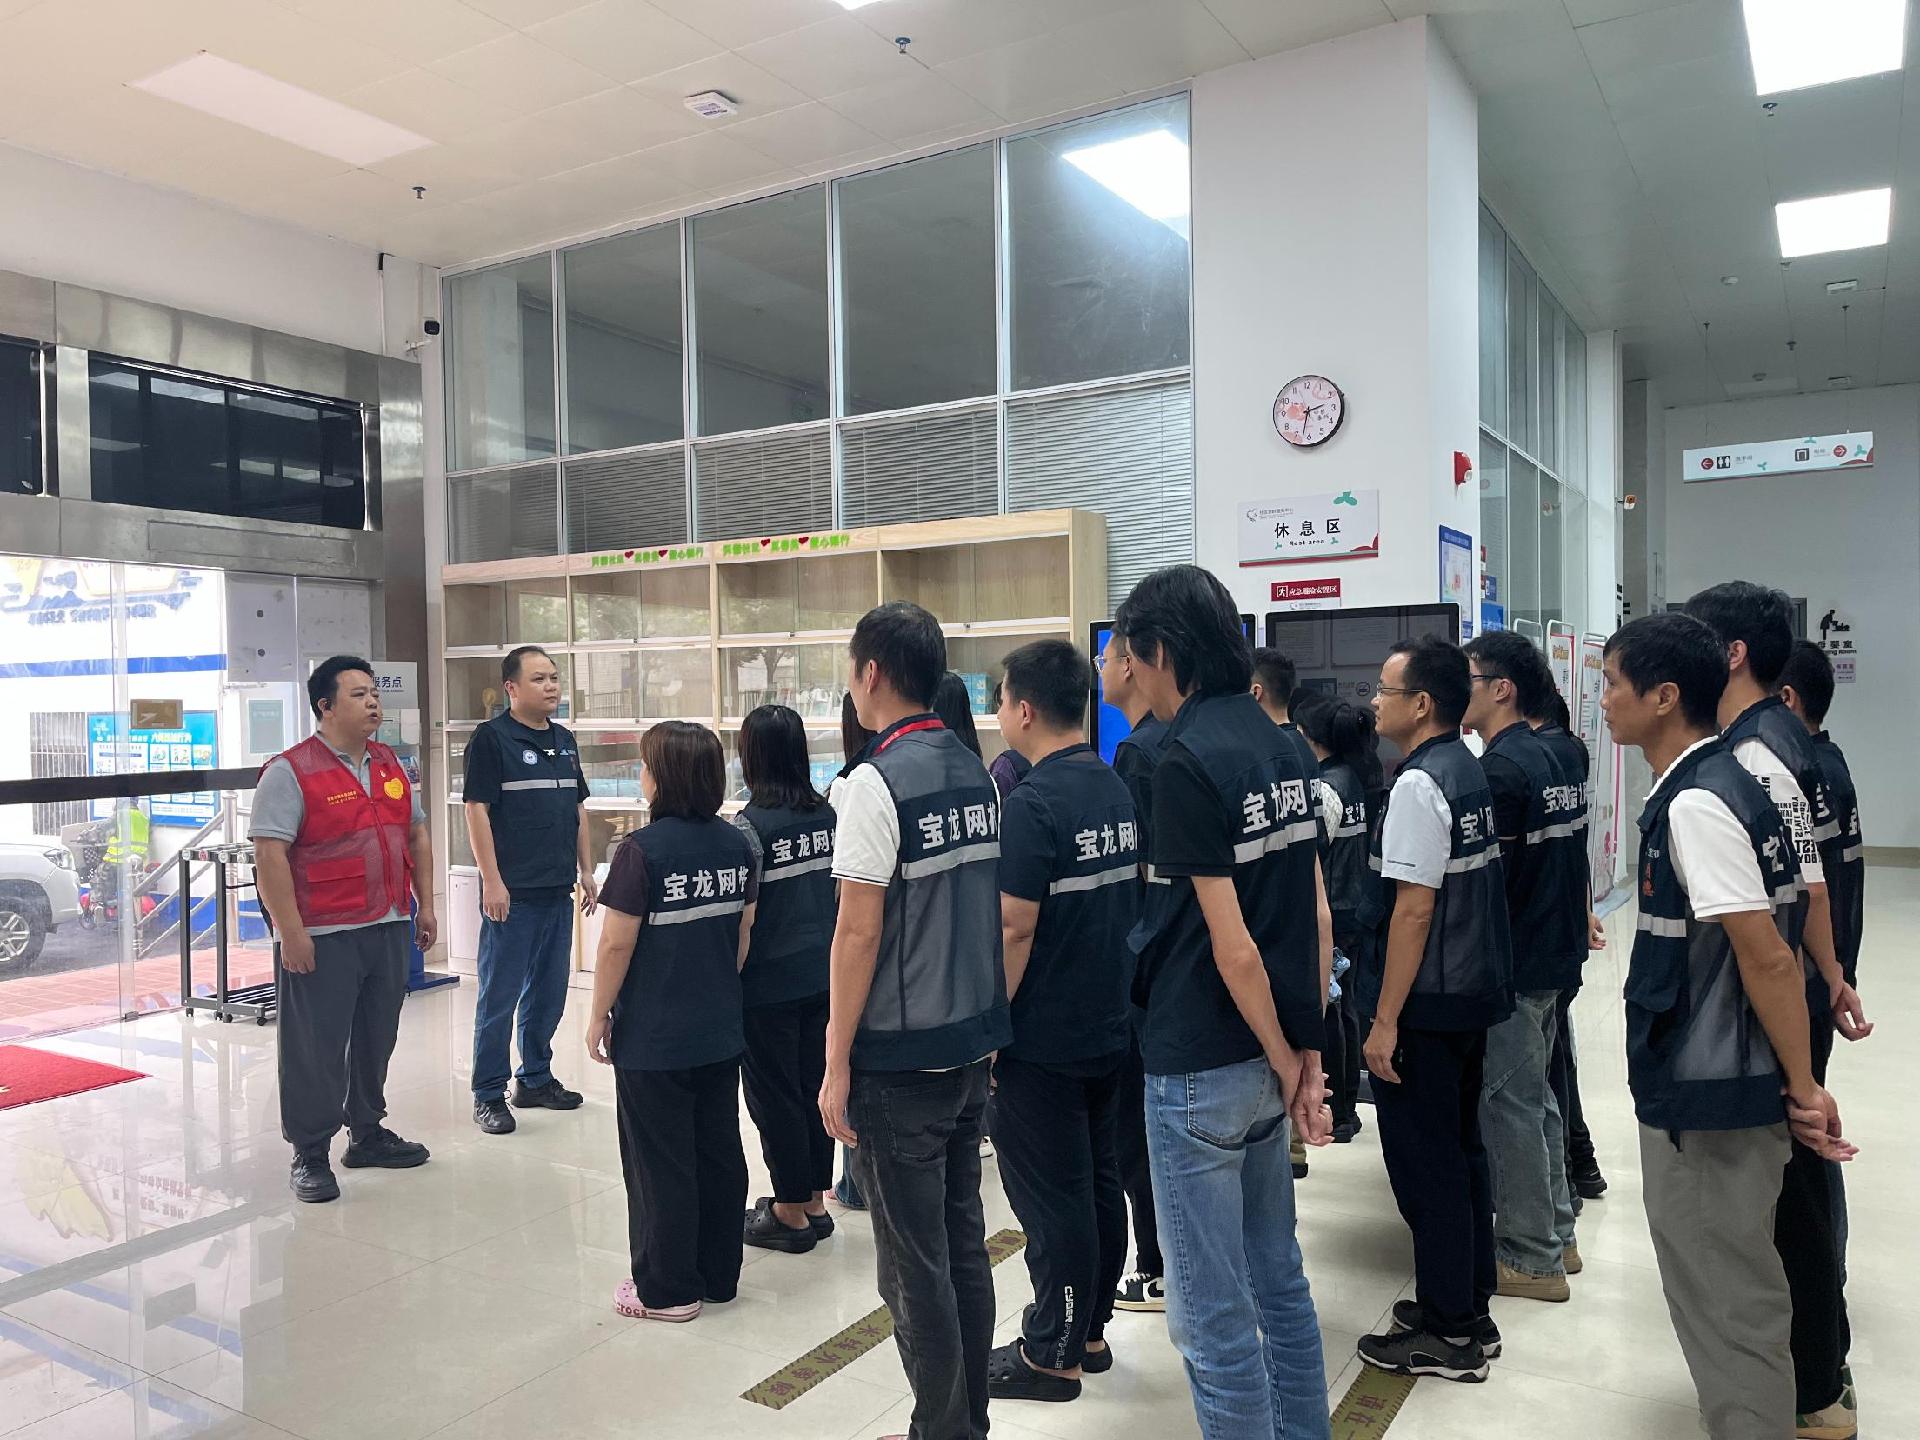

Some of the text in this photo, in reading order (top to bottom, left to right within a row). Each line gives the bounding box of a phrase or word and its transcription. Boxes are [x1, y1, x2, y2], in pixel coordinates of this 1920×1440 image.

[1274, 518, 1341, 539] 休息区
[771, 828, 836, 864] 宝龙网
[1075, 820, 1138, 862] 宝龙网
